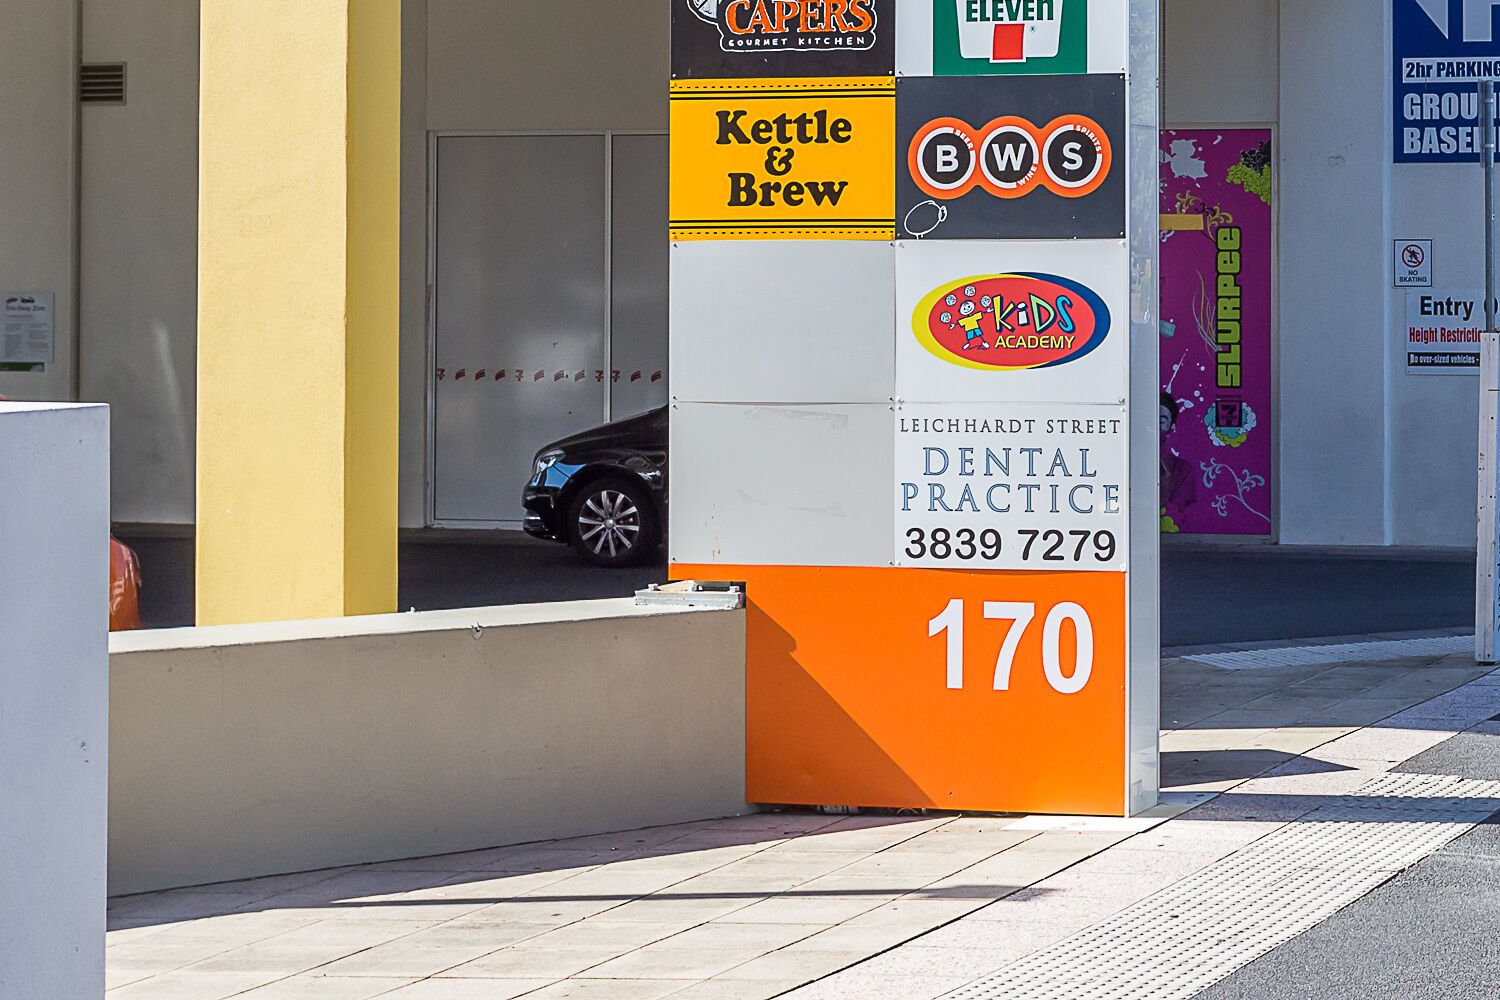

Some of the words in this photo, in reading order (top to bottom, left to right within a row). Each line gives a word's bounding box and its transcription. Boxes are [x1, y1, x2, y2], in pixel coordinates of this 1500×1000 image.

[728, 37, 788, 47] GOURMET
[798, 36, 866, 46] KITCHEN
[1405, 60, 1432, 79] 2hr
[715, 109, 852, 145] Kettle
[955, 129, 975, 150] BEER
[1074, 124, 1103, 153] SPIRITS
[764, 146, 793, 176] &
[1016, 163, 1038, 188] WINE
[727, 172, 849, 207] Brew
[1420, 296, 1474, 321] Entry
[994, 335, 1076, 350] ACADEMY
[1409, 327, 1438, 344] Height
[1441, 327, 1486, 343] Restrictio
[1420, 354, 1450, 364] over-sized
[1451, 354, 1475, 364] vehicles
[900, 418, 1036, 434] LEICHHARDT
[1046, 419, 1121, 434] STREET
[923, 447, 1097, 478] DENTAL
[901, 482, 1120, 515] PRACTICE
[904, 527, 1002, 560] 3839
[1017, 529, 1116, 562] 7279
[928, 598, 1094, 694] 170
